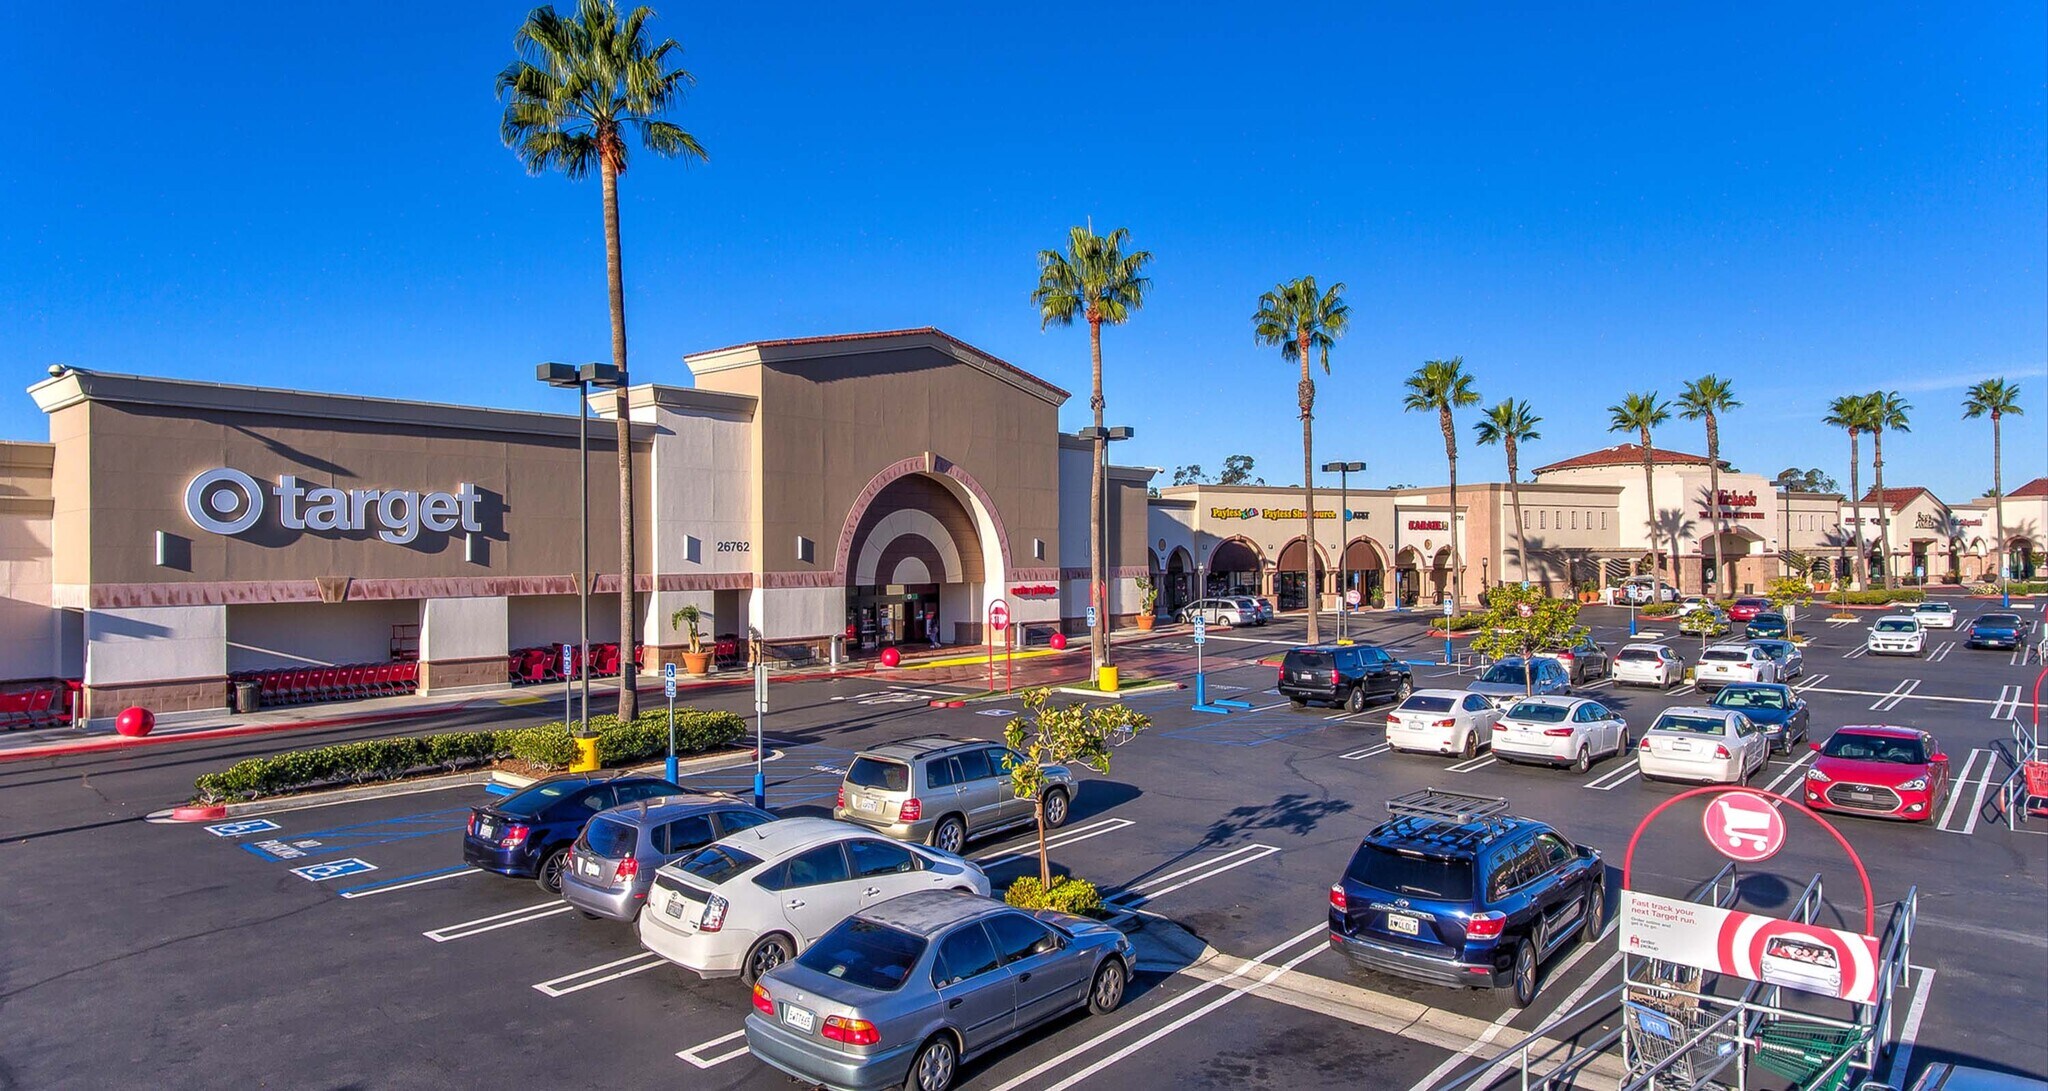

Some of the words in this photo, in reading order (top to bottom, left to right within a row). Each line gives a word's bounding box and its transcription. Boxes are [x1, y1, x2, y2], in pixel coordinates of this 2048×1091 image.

[273, 475, 482, 544] target
[1211, 507, 1241, 519] Payless
[1262, 508, 1292, 521] Payless
[1292, 508, 1337, 520] Shoource
[717, 541, 751, 552] 26762
[990, 613, 1007, 624] STOP
[1631, 898, 1649, 908] Fast
[1652, 902, 1673, 912] track
[1675, 907, 1694, 916] your
[1631, 907, 1649, 916] next
[1651, 910, 1678, 921] Target
[1680, 917, 1698, 925] run.
